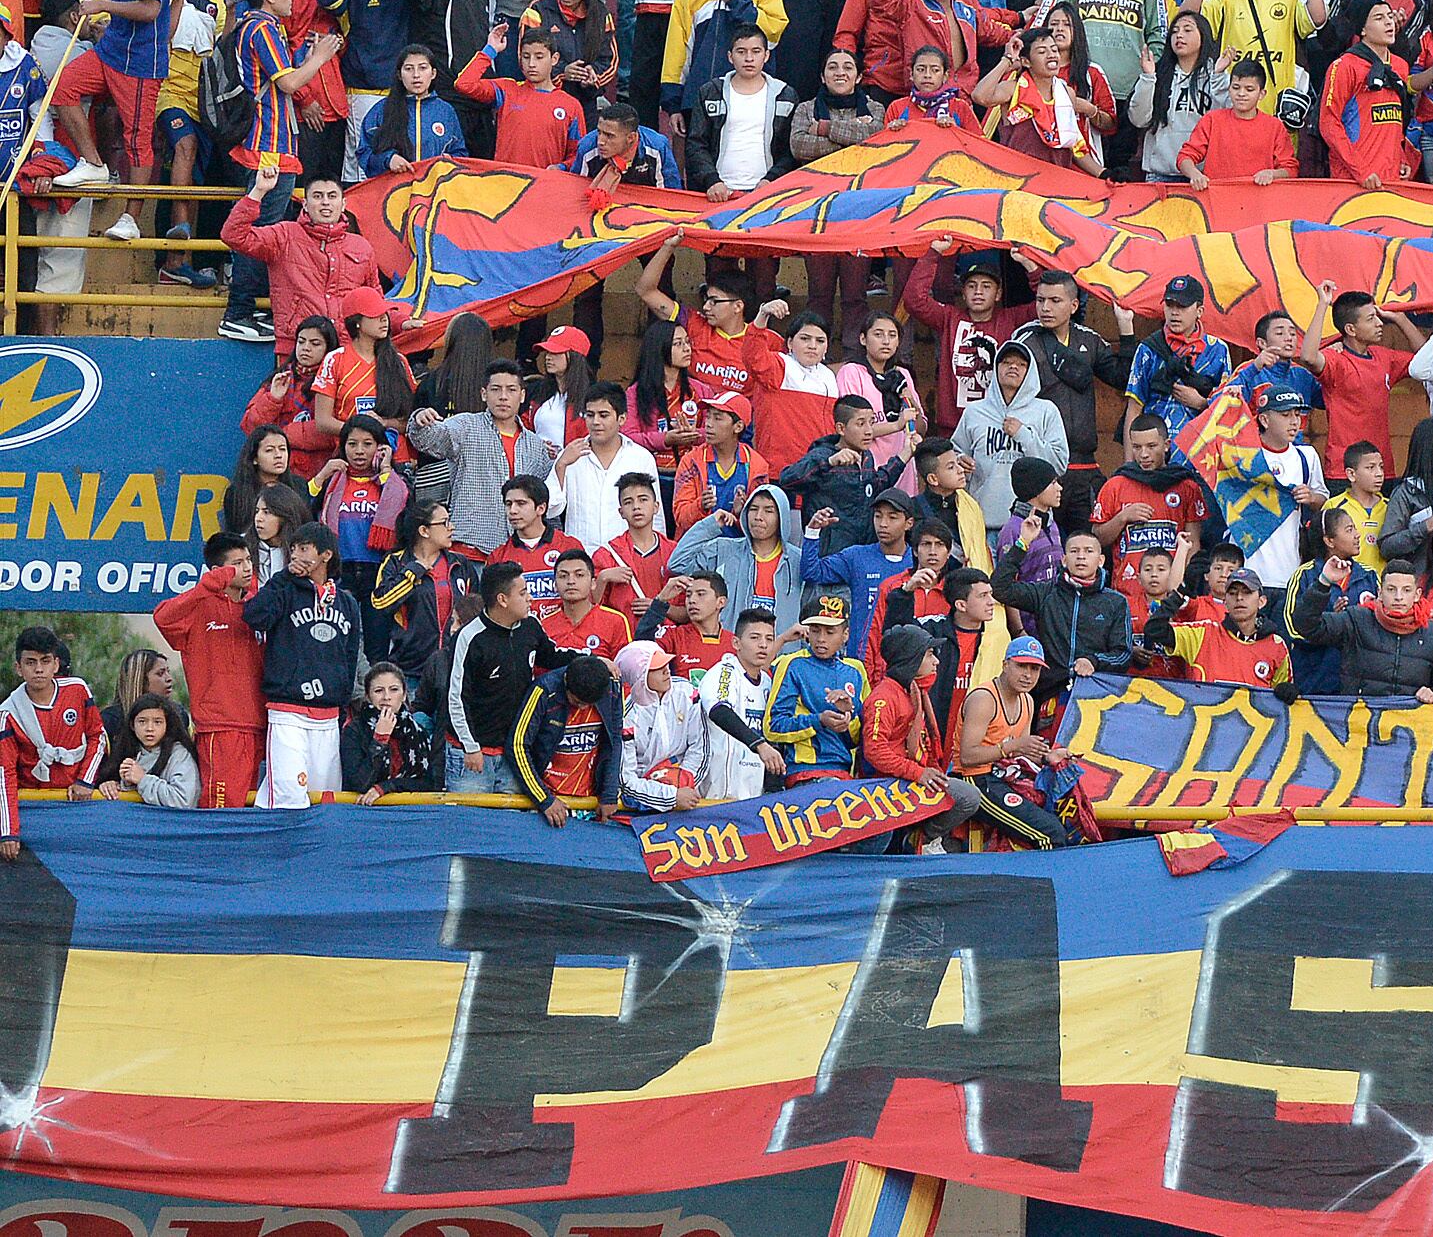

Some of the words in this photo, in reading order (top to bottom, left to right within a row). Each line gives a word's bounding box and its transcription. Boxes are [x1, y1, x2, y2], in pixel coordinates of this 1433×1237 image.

[1078, 5, 1138, 25] NARIÑO
[695, 363, 748, 382] NARIÑO
[527, 574, 557, 591] RIÑ
[290, 602, 352, 637] HOODIES
[301, 679, 324, 700] 90
[559, 731, 597, 746] ARIÑ
[640, 819, 749, 875] San
[758, 778, 945, 852] Vicente
